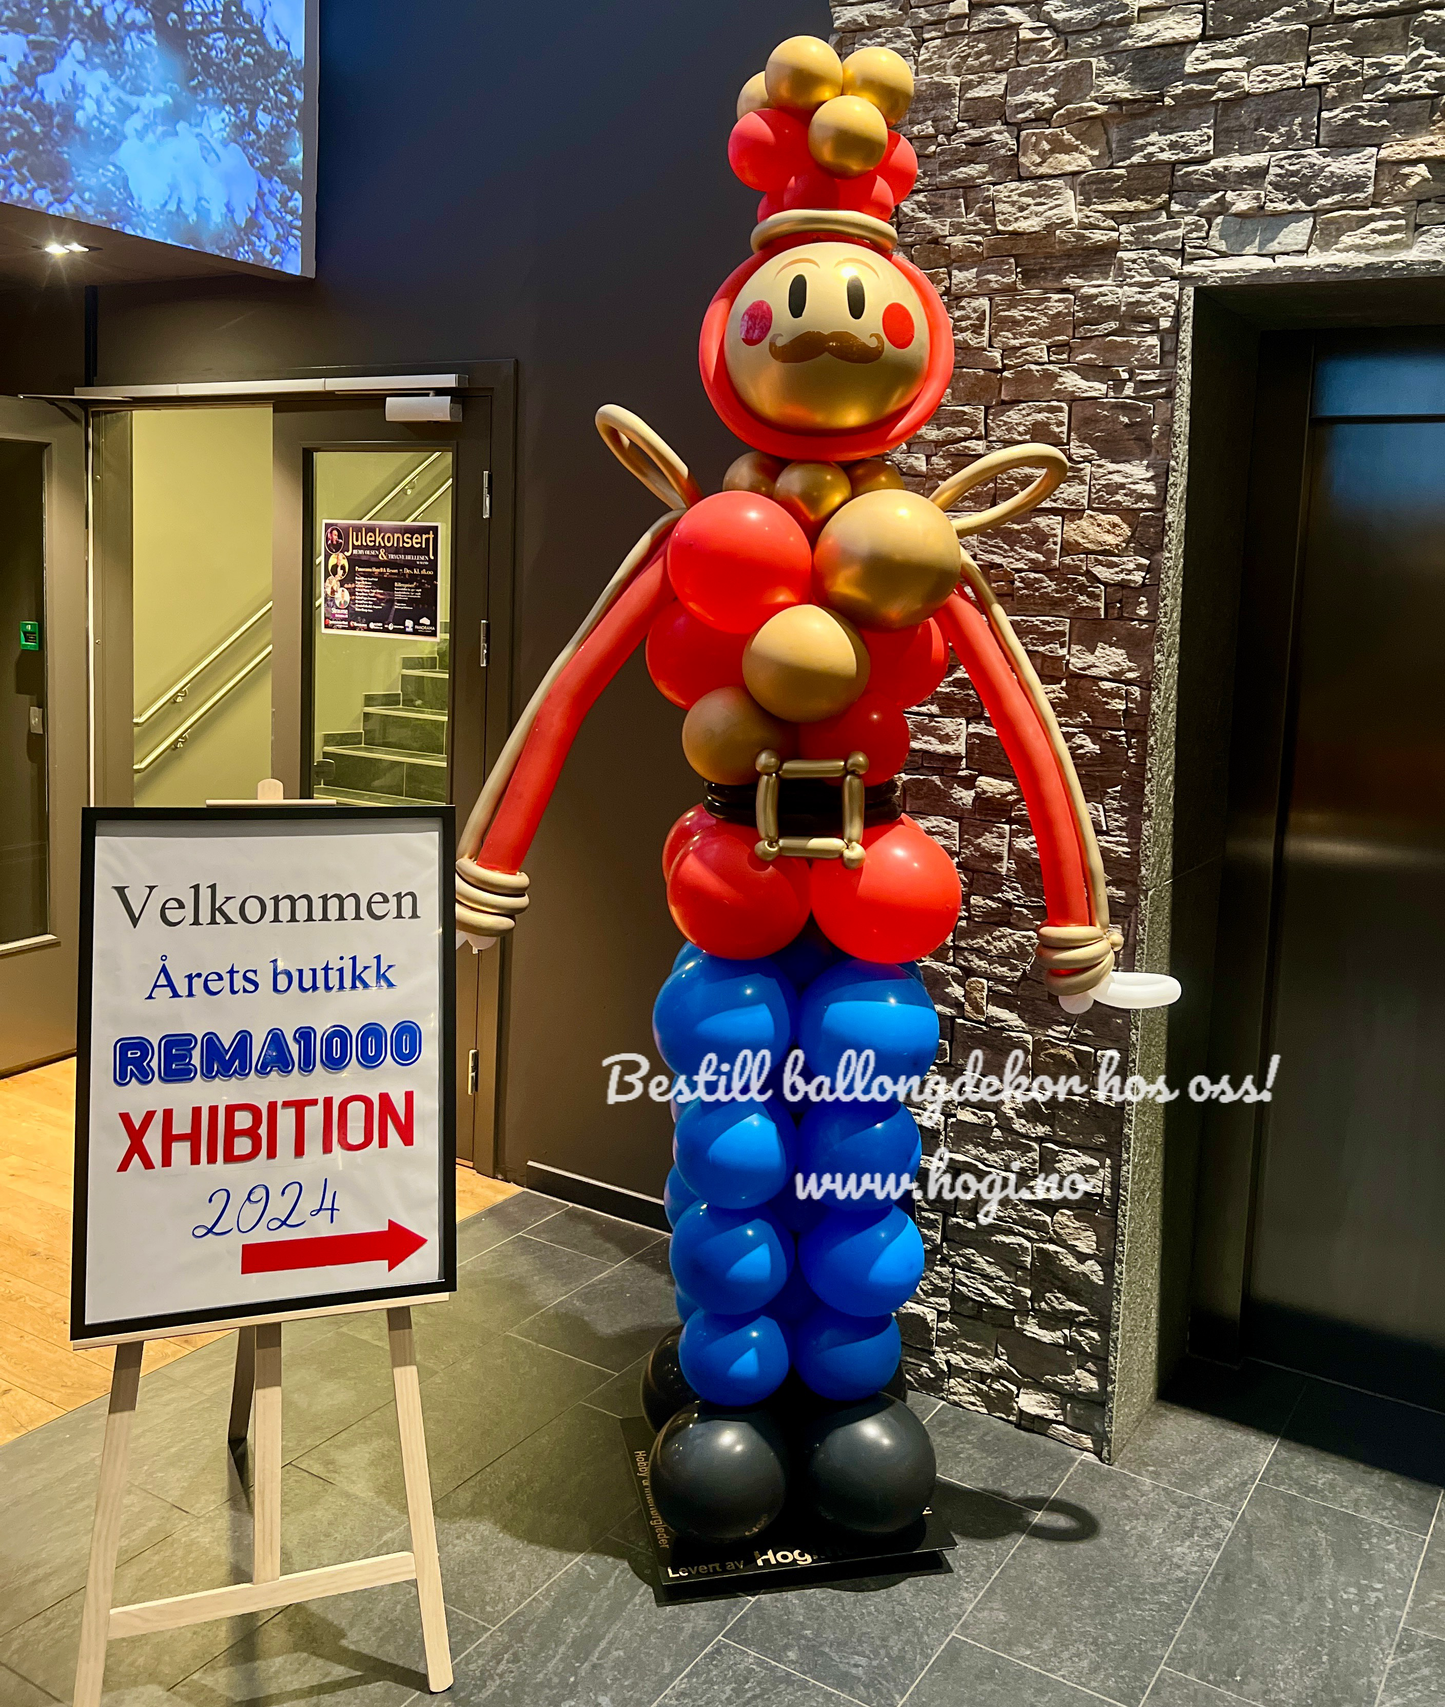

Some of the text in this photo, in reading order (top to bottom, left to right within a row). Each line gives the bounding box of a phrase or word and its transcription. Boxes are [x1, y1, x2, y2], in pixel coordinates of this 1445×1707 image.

[344, 527, 435, 560] Julekonsert
[112, 883, 421, 929] Velkommen
[145, 954, 397, 1000] Årets butikk
[117, 1090, 415, 1173] XHIBITION
[191, 1177, 341, 1239] 2024
[634, 1450, 648, 1477] Hobby
[667, 1561, 721, 1578] Levert
[725, 1560, 744, 1571] av
